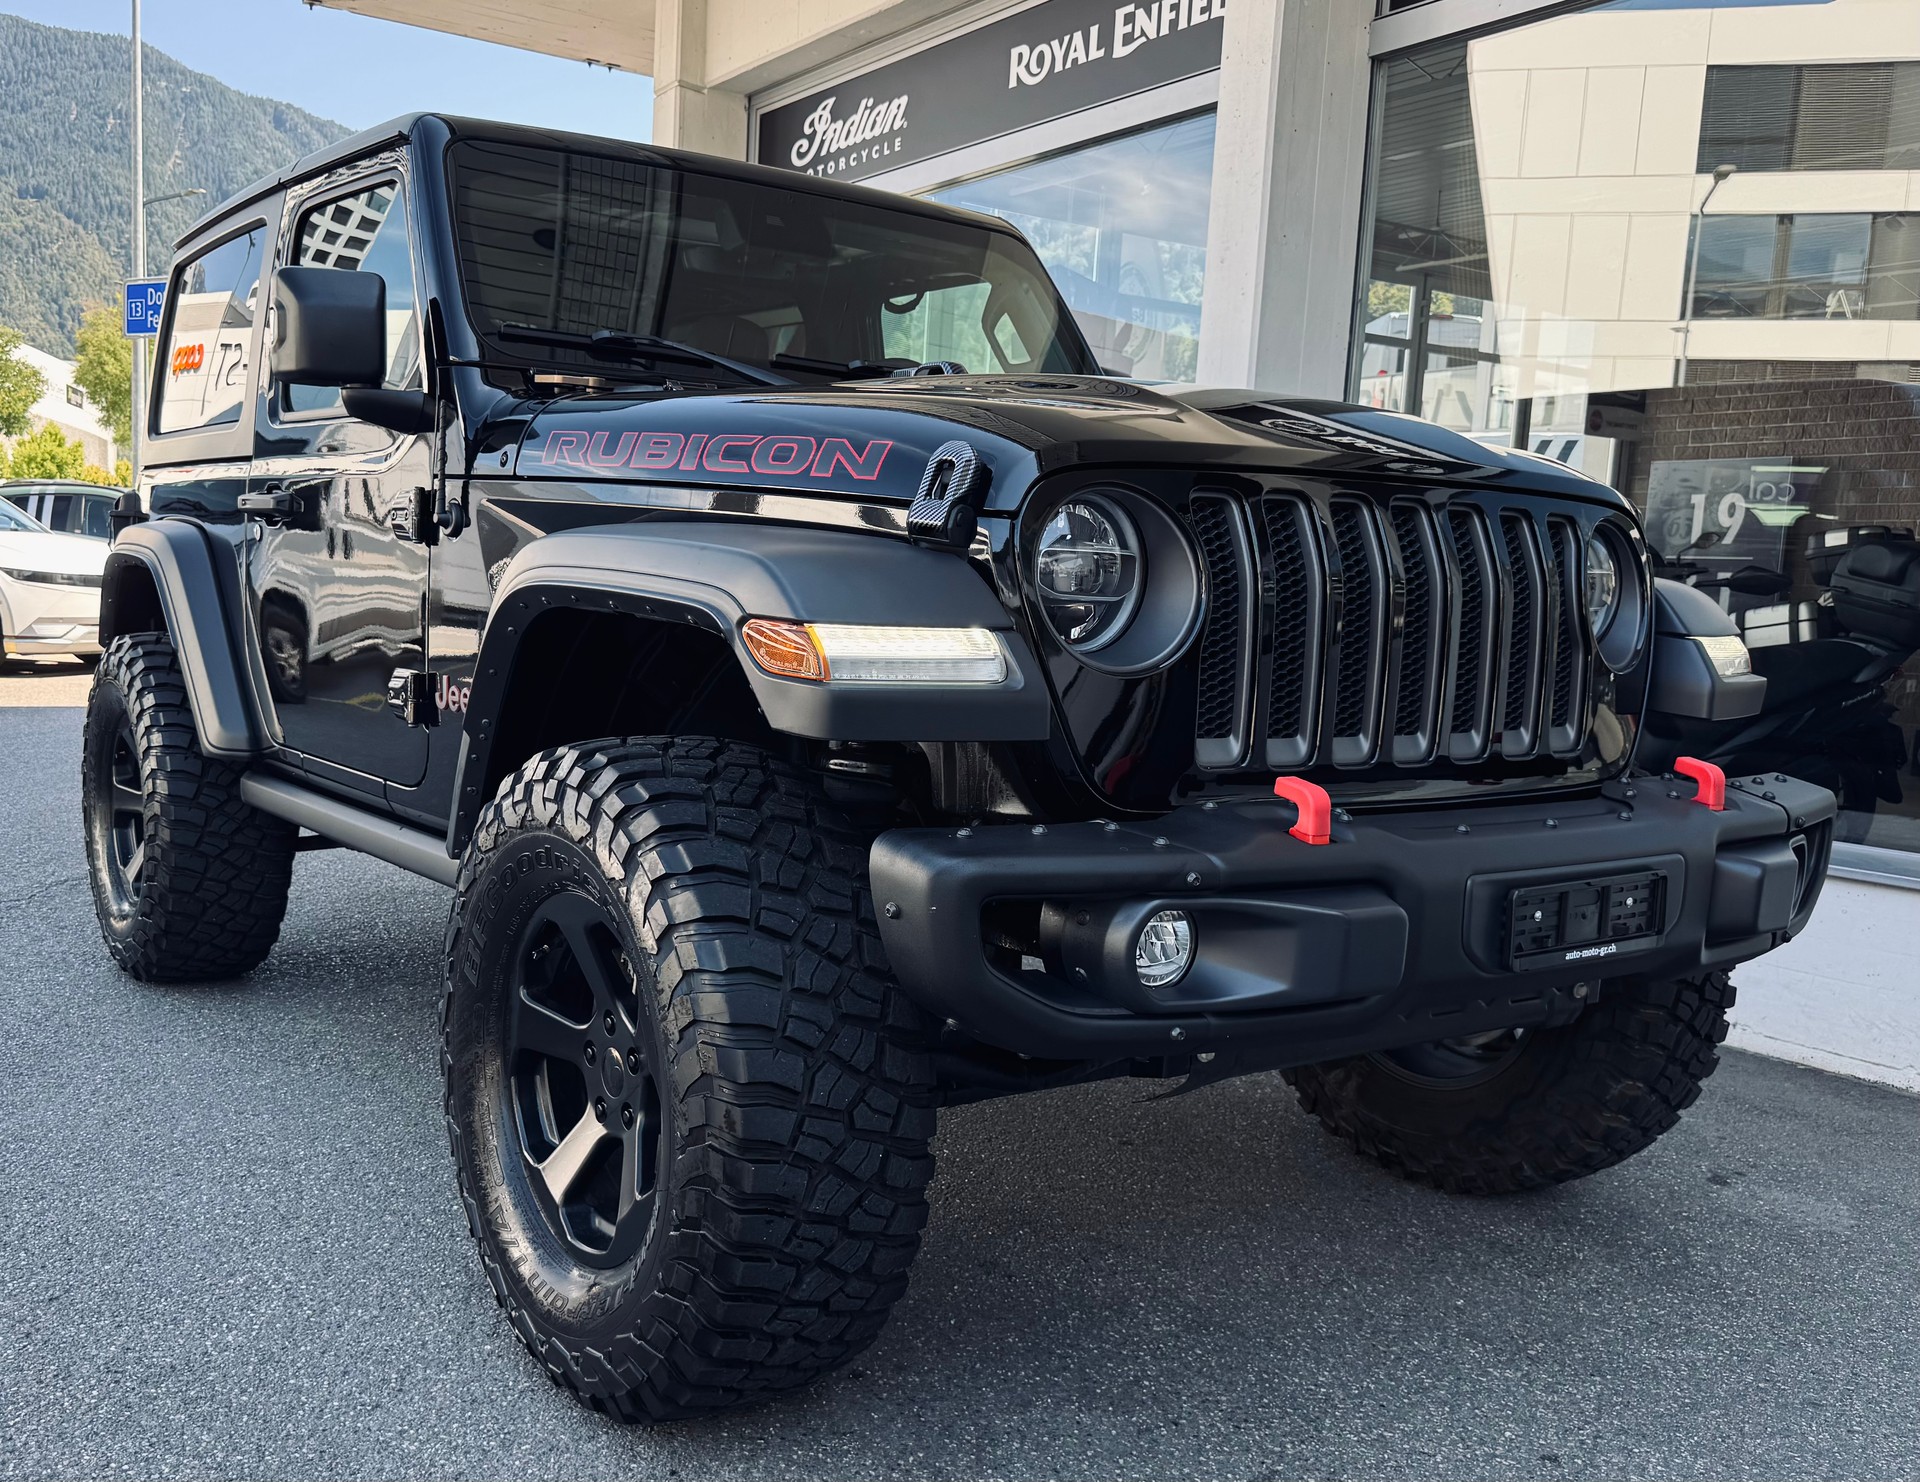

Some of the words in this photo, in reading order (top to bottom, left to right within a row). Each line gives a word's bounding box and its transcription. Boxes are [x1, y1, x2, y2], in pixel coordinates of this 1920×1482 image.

[1008, 23, 1106, 90] ROYAL
[1112, 0, 1226, 59] ENFIEL
[790, 94, 909, 167] Indian
[806, 136, 902, 178] OTORCYCLE
[131, 302, 142, 317] 13
[147, 287, 165, 306] Do
[147, 310, 160, 329] Fe
[541, 430, 894, 481] RUBICON
[1690, 492, 1747, 545] 19
[434, 674, 471, 714] Jee
[1564, 942, 1617, 960] auto-moto-gr.ch
